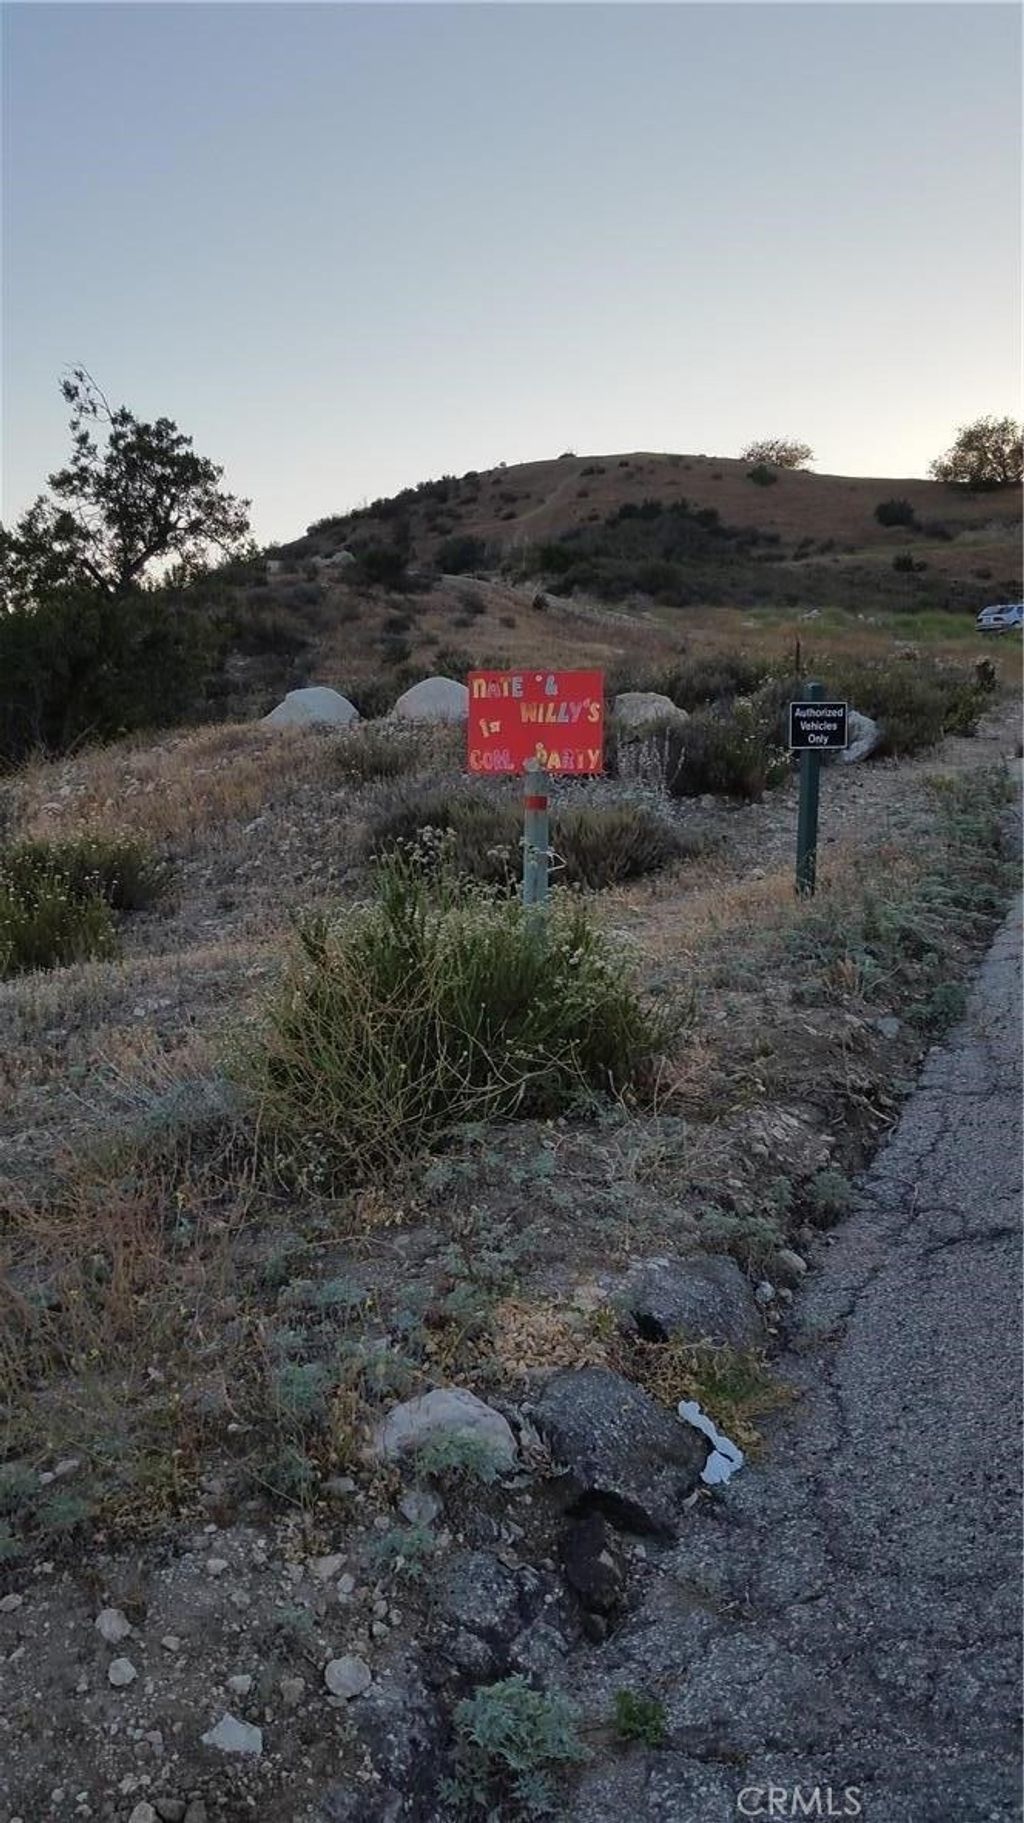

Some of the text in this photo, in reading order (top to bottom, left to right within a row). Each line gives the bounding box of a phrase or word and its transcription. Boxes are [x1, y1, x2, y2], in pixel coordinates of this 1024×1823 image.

[544, 675, 558, 696] &
[520, 699, 600, 723] WILLY'S
[795, 708, 844, 718] Authorized
[800, 720, 838, 731] Vehicles
[808, 733, 829, 746] Only
[536, 748, 600, 770] PARTY
